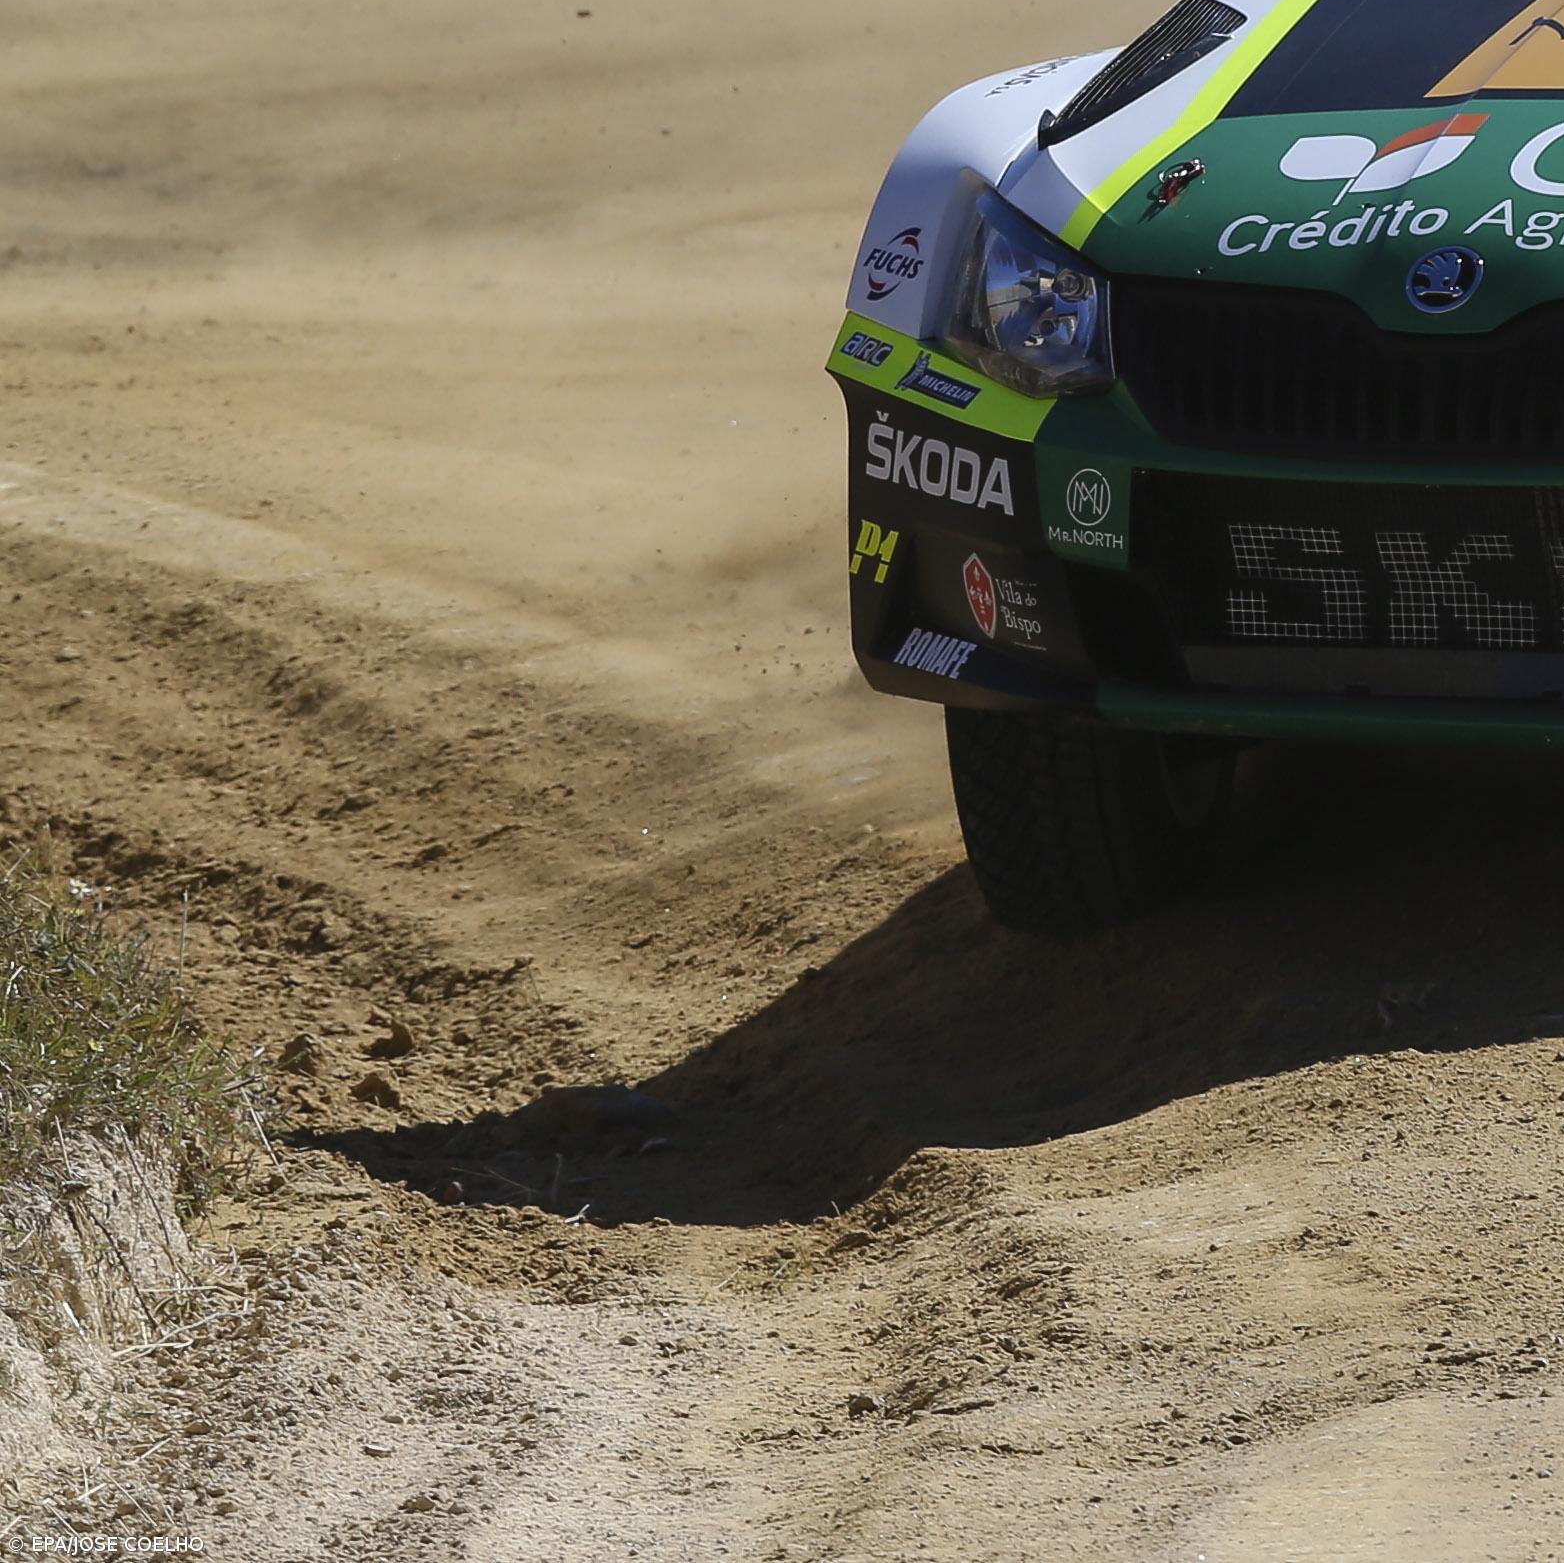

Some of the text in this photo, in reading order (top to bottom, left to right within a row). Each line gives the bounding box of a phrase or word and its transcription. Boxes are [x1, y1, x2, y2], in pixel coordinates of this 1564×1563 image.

[1217, 198, 1449, 257] Crédito
[863, 247, 924, 280] FUCHS
[918, 375, 976, 403] MICHELIN
[866, 410, 1014, 516] ŠKODA
[849, 519, 899, 584] P1
[995, 578, 1037, 607] Vila do
[1001, 605, 1042, 641] Bispo
[893, 629, 977, 679] ROMAFE
